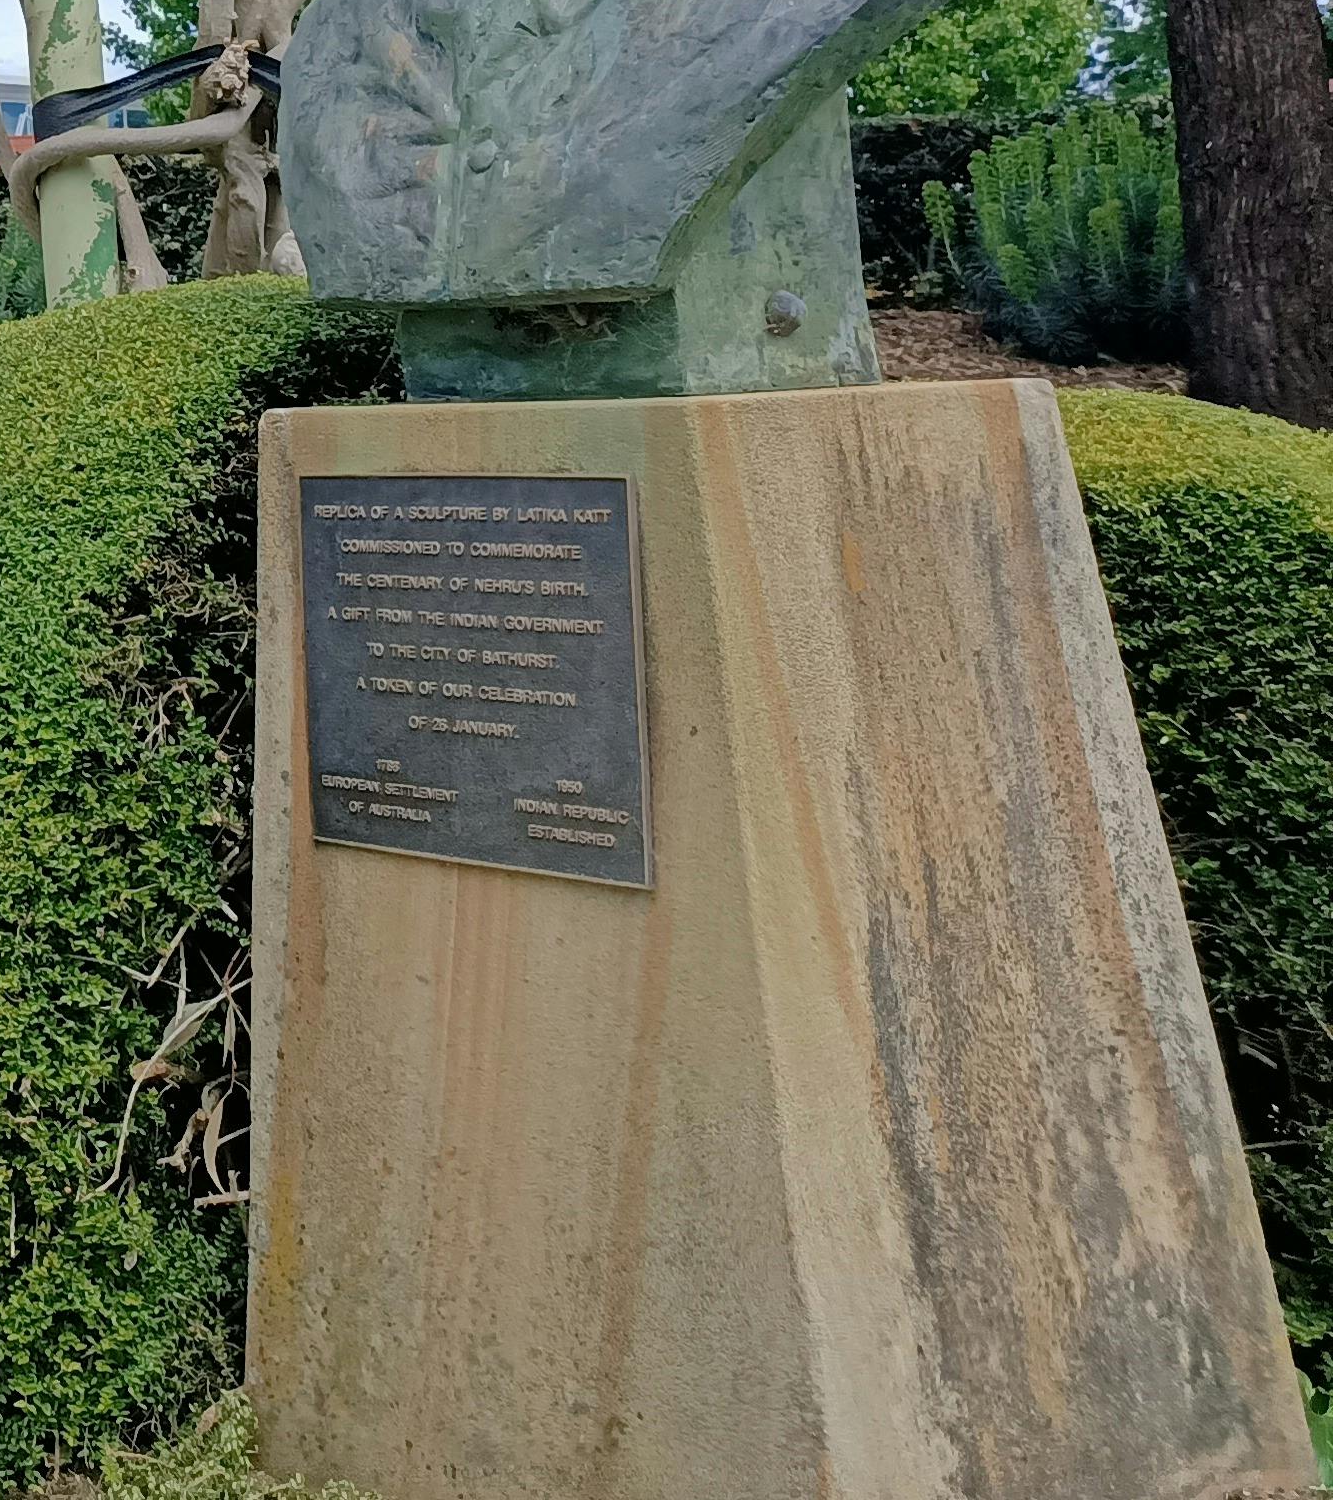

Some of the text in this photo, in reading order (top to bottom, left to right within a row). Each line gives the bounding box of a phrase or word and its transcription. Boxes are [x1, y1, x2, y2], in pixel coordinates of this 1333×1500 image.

[314, 504, 612, 523] REPLICA OF A SCULPTURE BY LATIKA KATT
[340, 539, 583, 560] COMMISSIONED TO COMMEMORATE
[336, 572, 590, 597] THE CENTENARY OF NEHRU'S BIRTH.
[327, 606, 605, 634] A GIFT FROM THE INDIAN GOVERNMENT
[366, 642, 560, 669] TO THE CITY OF BATHURST.
[356, 676, 577, 707] A TOKEN OF OUR CELEBRATION
[408, 715, 520, 739] OF 26 JANUARY.
[321, 774, 460, 803] EUROPEAN SETTLEMENT
[555, 779, 583, 794] 1950
[348, 800, 432, 823] OF AUSTRALIA
[513, 798, 631, 825] INDIAN REPUBLIC
[527, 823, 616, 847] ESTABLISHED
